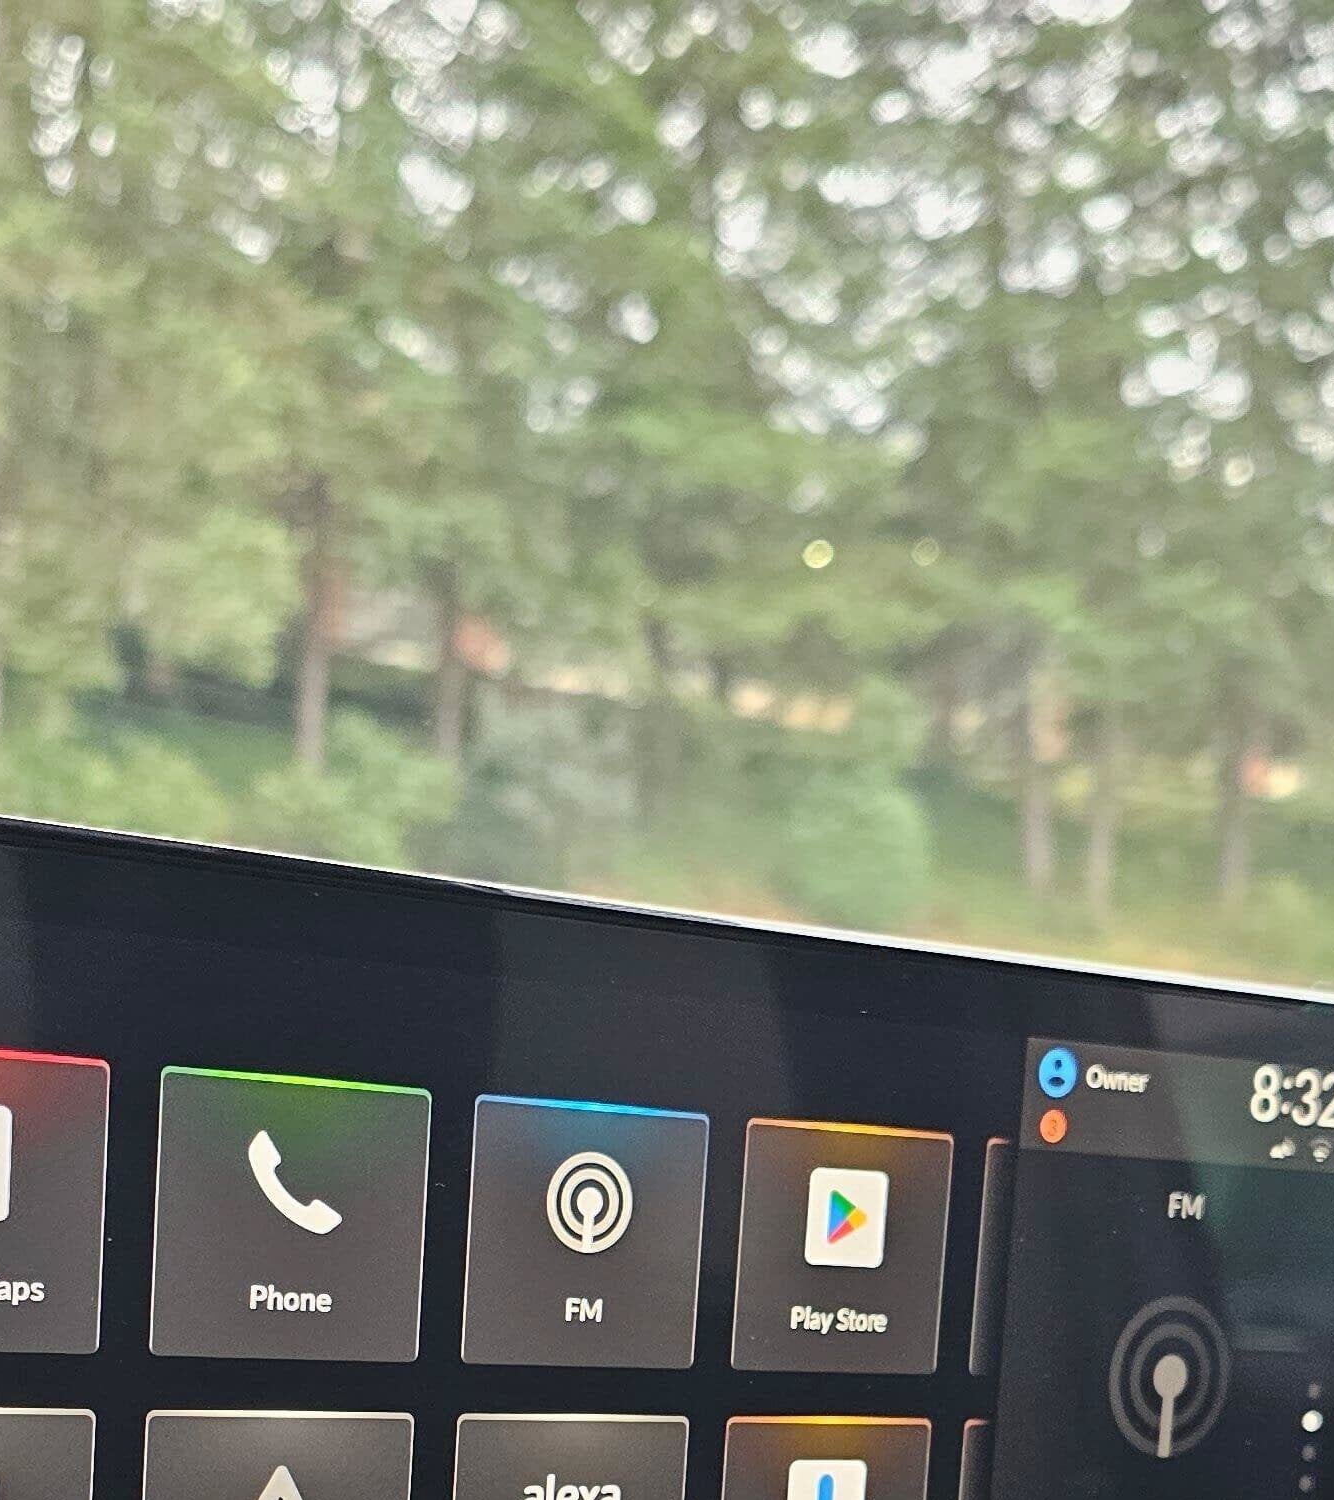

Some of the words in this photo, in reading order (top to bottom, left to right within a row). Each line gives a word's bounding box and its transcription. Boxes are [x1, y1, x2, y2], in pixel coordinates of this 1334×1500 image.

[1085, 1063, 1150, 1094] Owner
[1167, 1191, 1206, 1221] FM
[249, 1283, 333, 1313] Phone
[564, 1297, 604, 1324] FM
[790, 1305, 835, 1335] Play
[837, 1307, 888, 1334] Store
